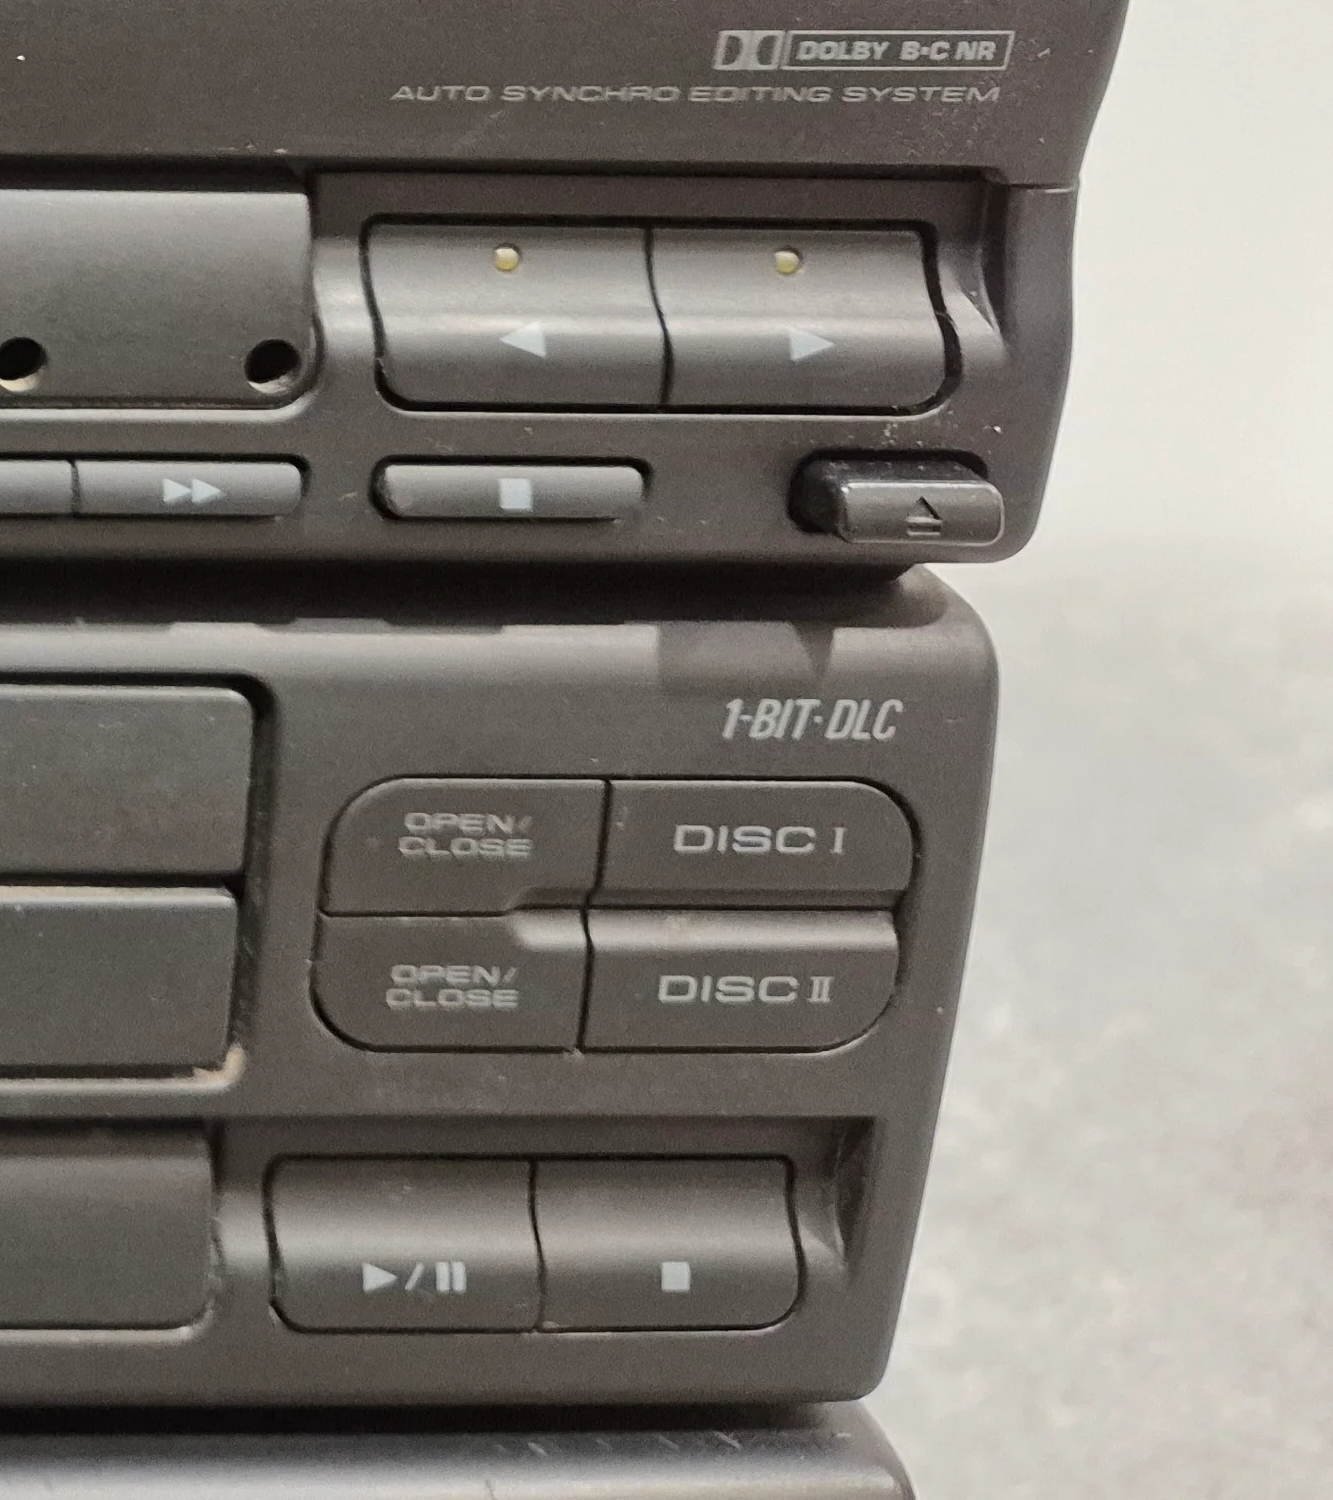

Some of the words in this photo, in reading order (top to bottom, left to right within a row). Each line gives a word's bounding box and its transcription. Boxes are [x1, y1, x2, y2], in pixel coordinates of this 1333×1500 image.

[796, 41, 889, 61] DOLBY
[954, 41, 997, 61] NR
[390, 84, 492, 102] AUTO
[502, 84, 680, 103] SYNCHRO
[690, 85, 831, 103] EDITING
[841, 85, 1002, 103] SYSTEM
[397, 835, 533, 859] CLOSE
[673, 825, 817, 855] DISC
[385, 987, 520, 1011] CLOSE
[657, 975, 801, 1005] DISC
